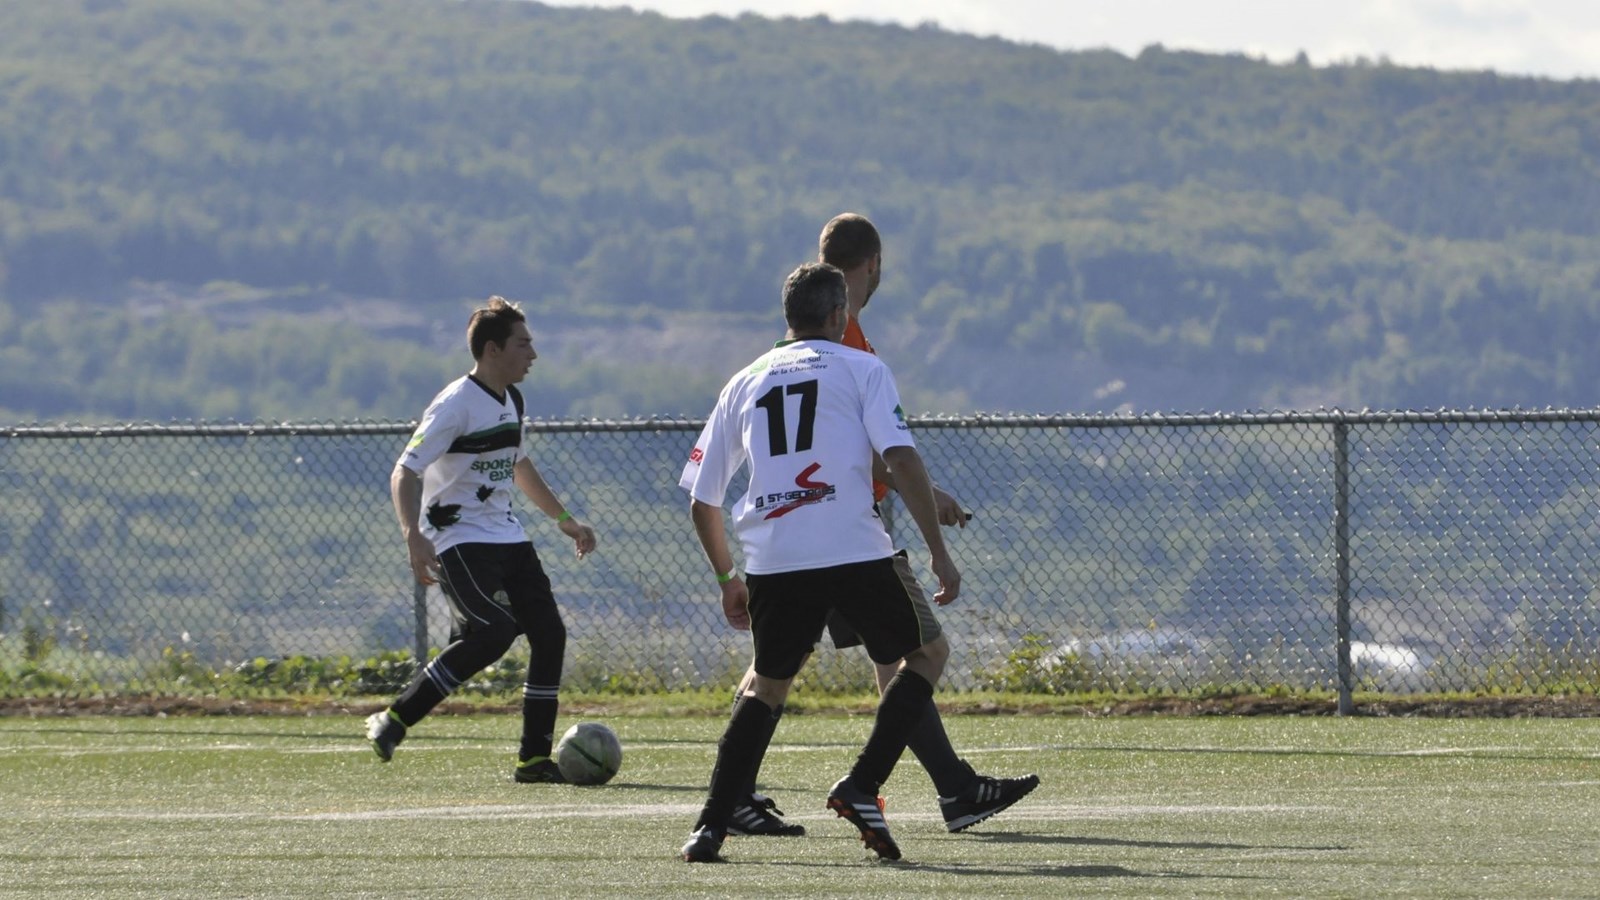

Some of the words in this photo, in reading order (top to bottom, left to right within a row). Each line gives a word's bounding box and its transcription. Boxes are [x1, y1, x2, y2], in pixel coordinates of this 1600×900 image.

[771, 360, 794, 369] Caisse
[808, 355, 821, 363] Sud
[769, 369, 779, 377] de
[789, 364, 828, 373] Chaudière
[755, 379, 818, 457] 17
